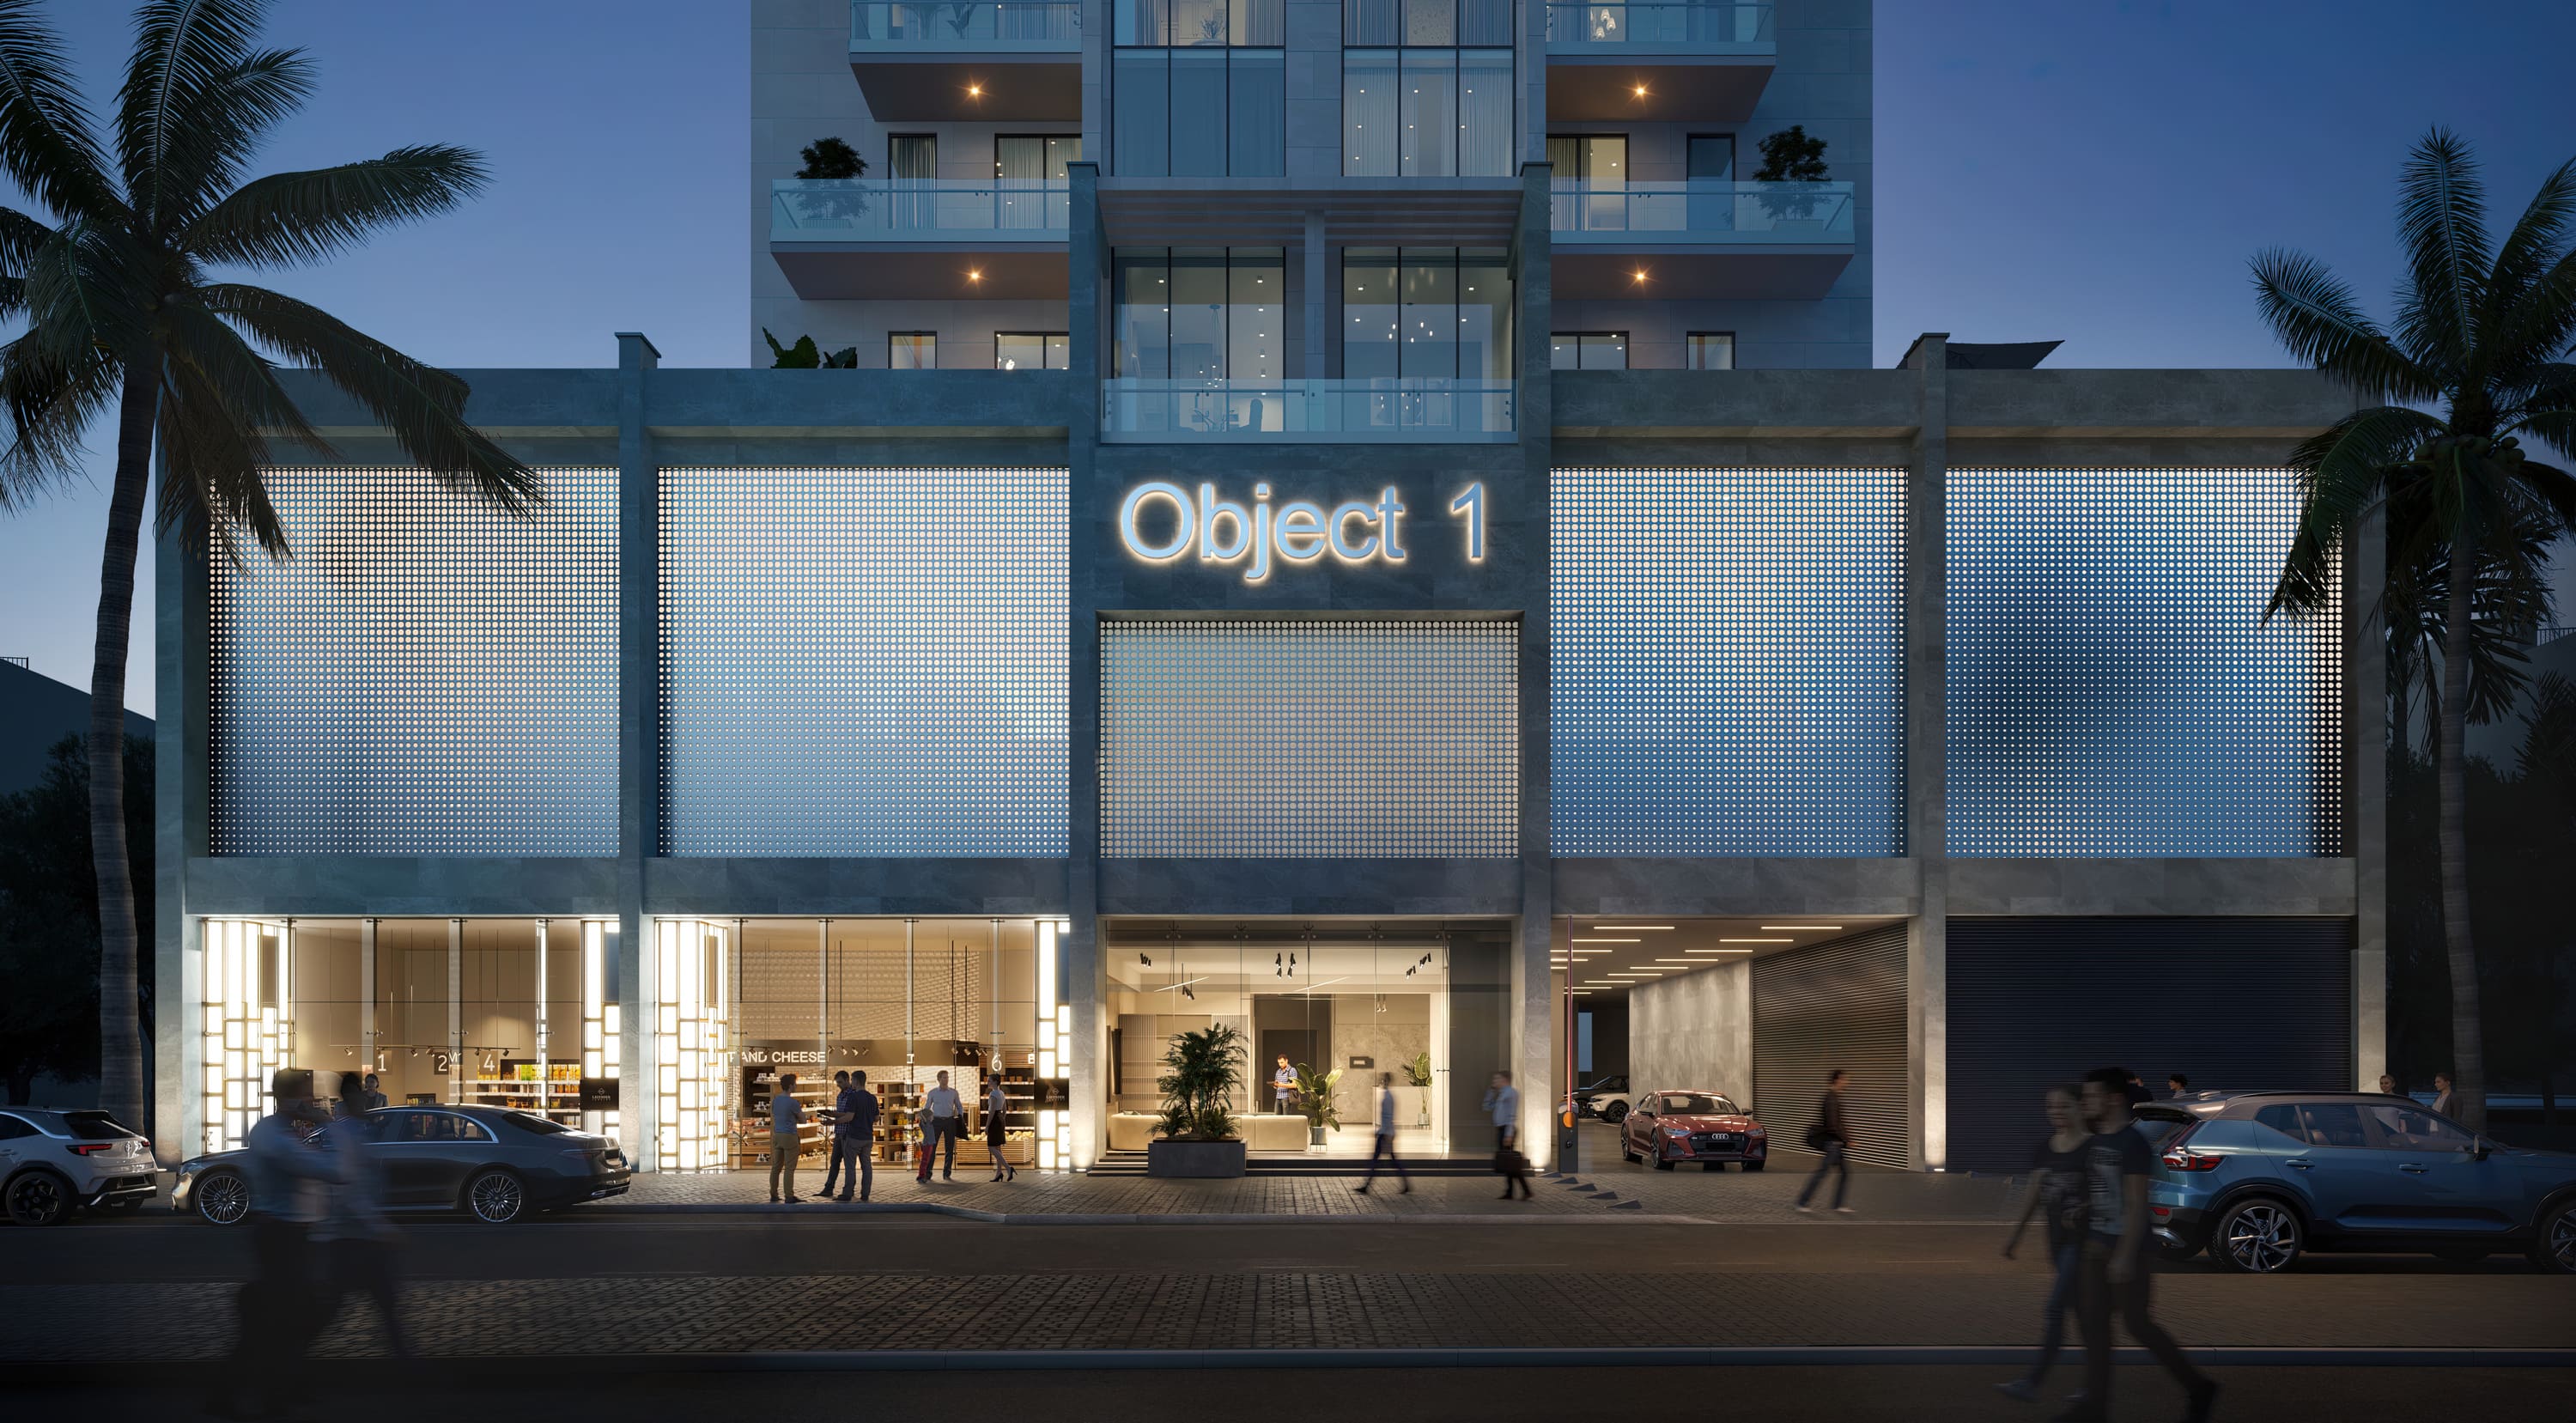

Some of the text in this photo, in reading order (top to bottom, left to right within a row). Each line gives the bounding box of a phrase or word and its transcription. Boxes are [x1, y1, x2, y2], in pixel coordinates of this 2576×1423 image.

[1121, 482, 1484, 579] Object 1
[378, 1054, 386, 1072] 1
[438, 1055, 447, 1072] 2
[483, 1054, 495, 1072] 4
[741, 1051, 768, 1063] AND
[771, 1051, 826, 1063] CHEESE
[991, 1054, 1002, 1072] 6
